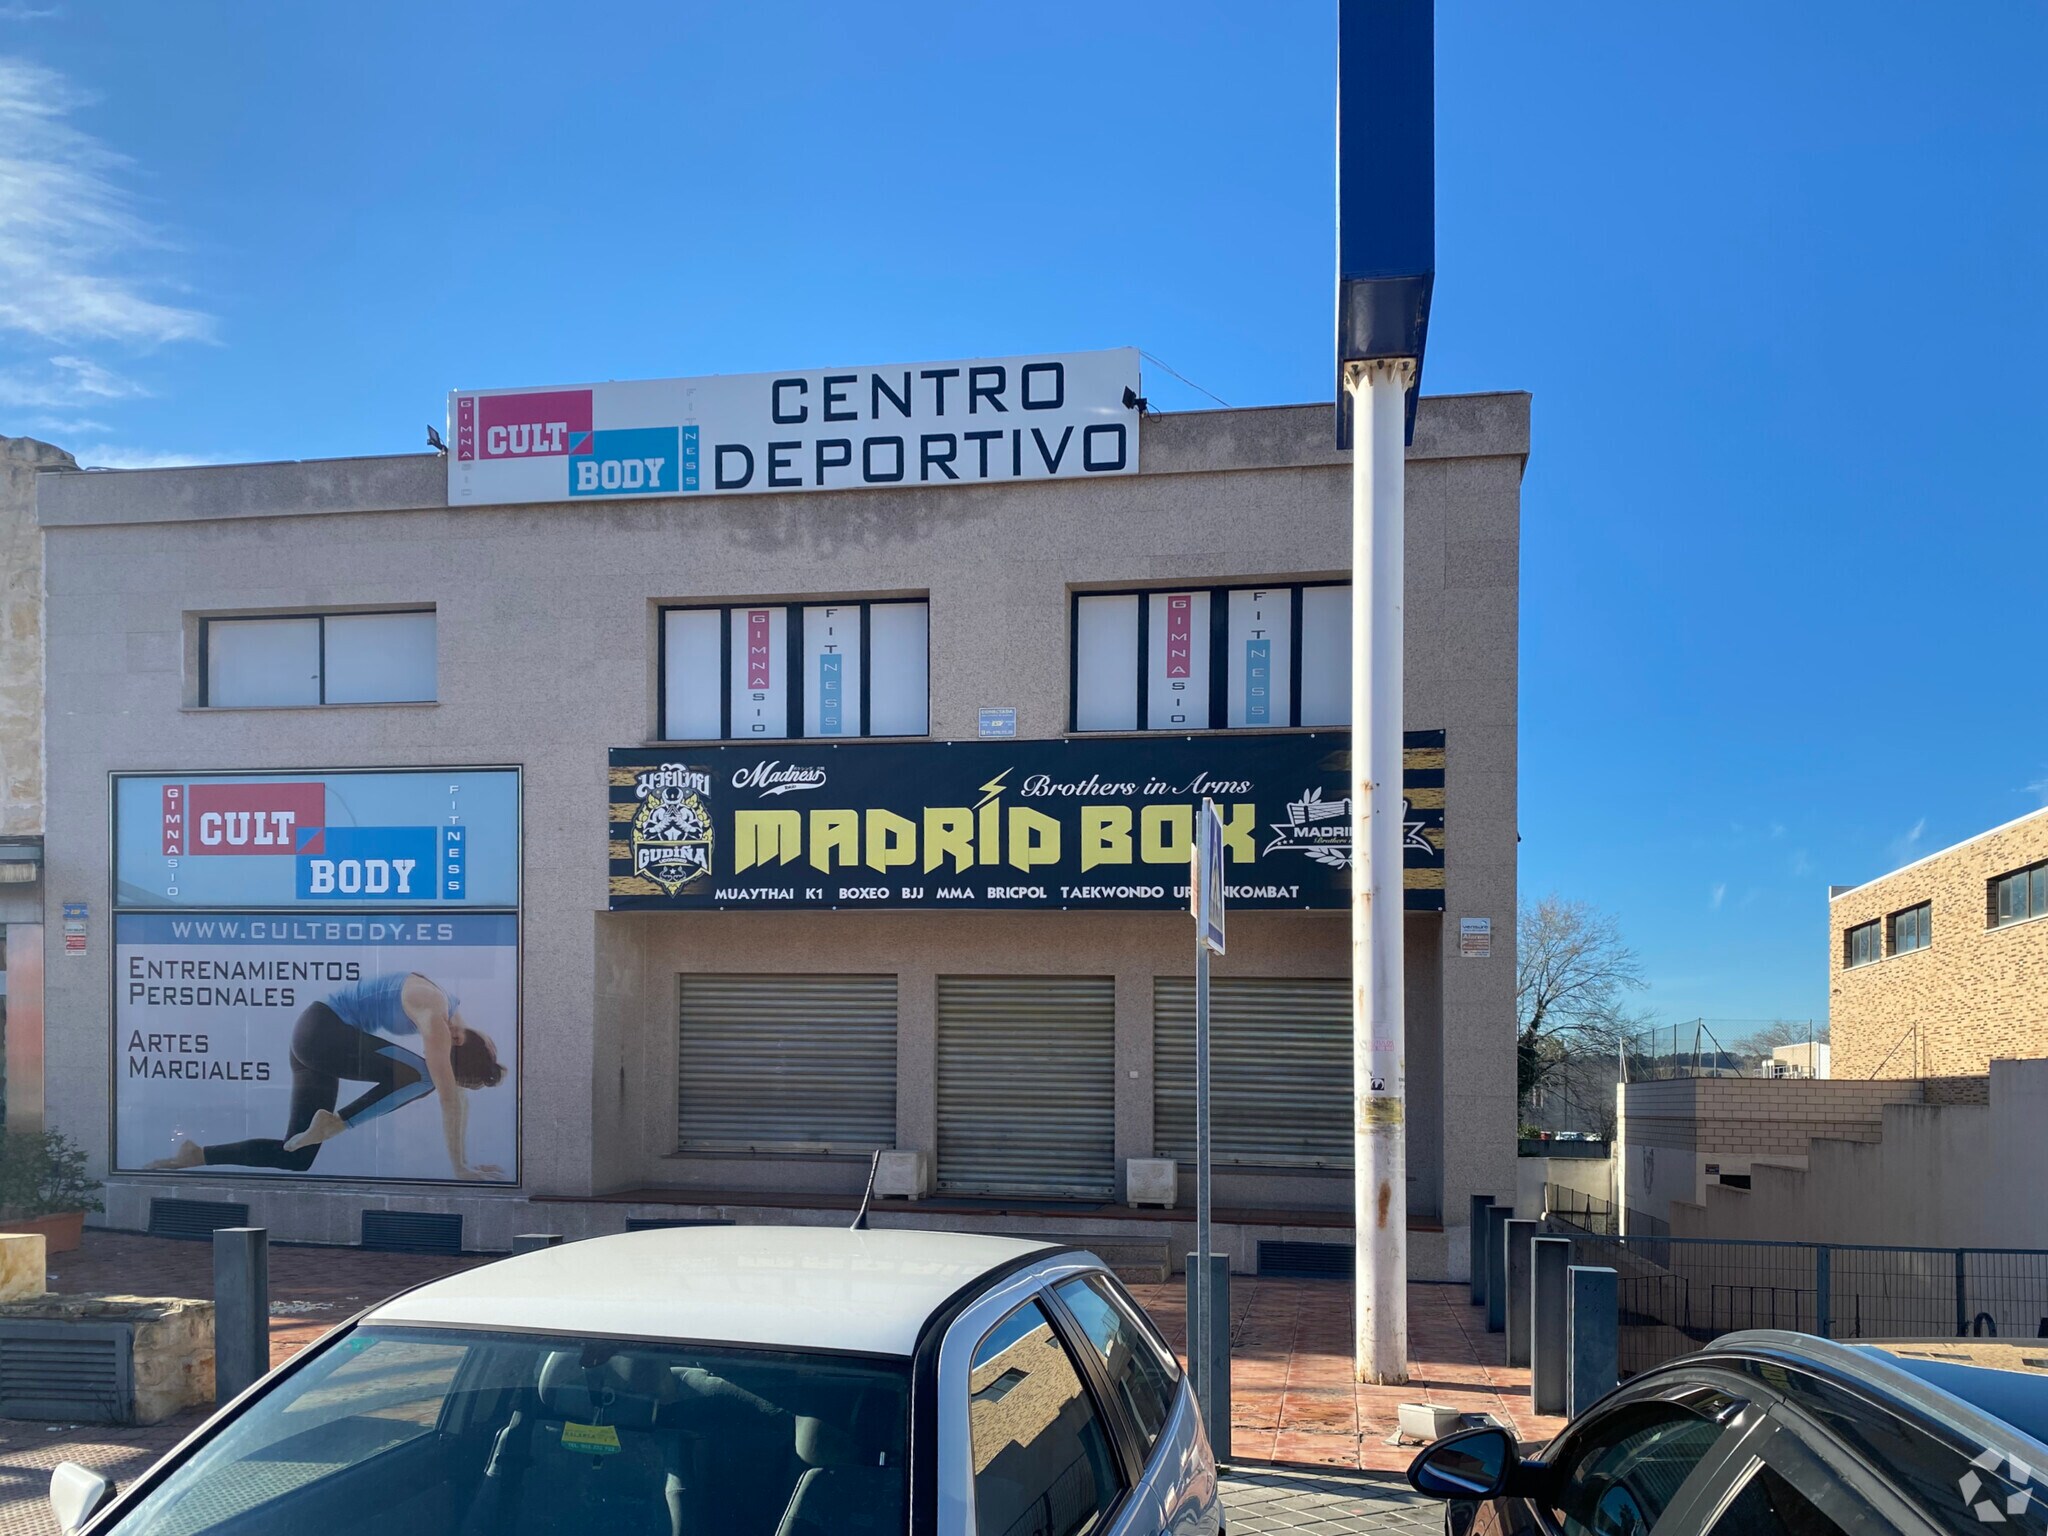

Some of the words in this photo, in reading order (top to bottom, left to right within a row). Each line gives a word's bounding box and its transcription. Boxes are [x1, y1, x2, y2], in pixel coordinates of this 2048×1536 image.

[771, 362, 1065, 426] CENTRO
[460, 400, 473, 496] GIMNASIO
[487, 421, 567, 455] CULT
[685, 388, 697, 485] FITNESS
[714, 422, 1126, 489] DEPORTIVO
[577, 457, 665, 491] BODY
[751, 614, 766, 733] GIMNASIO
[824, 609, 838, 727] FITNESS
[1171, 599, 1187, 723] GIMNASIO
[1250, 592, 1266, 717] FITNESS
[732, 760, 826, 790] Madness
[1021, 774, 1139, 798] Brothers
[1143, 776, 1171, 796] in
[1171, 771, 1255, 796] Arms
[165, 788, 181, 896] GIMNASIO
[200, 811, 295, 846] CULT
[447, 785, 461, 891] FITNESS
[638, 845, 708, 870] GUDIÑA
[1081, 804, 1256, 874] BOX
[310, 859, 416, 893] BODY
[714, 887, 794, 900] MUAYTHAI
[805, 887, 824, 900] K1
[838, 886, 890, 900] BOXEO
[901, 886, 925, 900] BJJ
[936, 886, 975, 900] MMA
[987, 886, 1047, 900] BRICPOL
[1060, 885, 1165, 899] TAEKWONDO
[1173, 885, 1300, 899] URNKOMBAT
[172, 921, 454, 941] WWW.CULTBODY.ES
